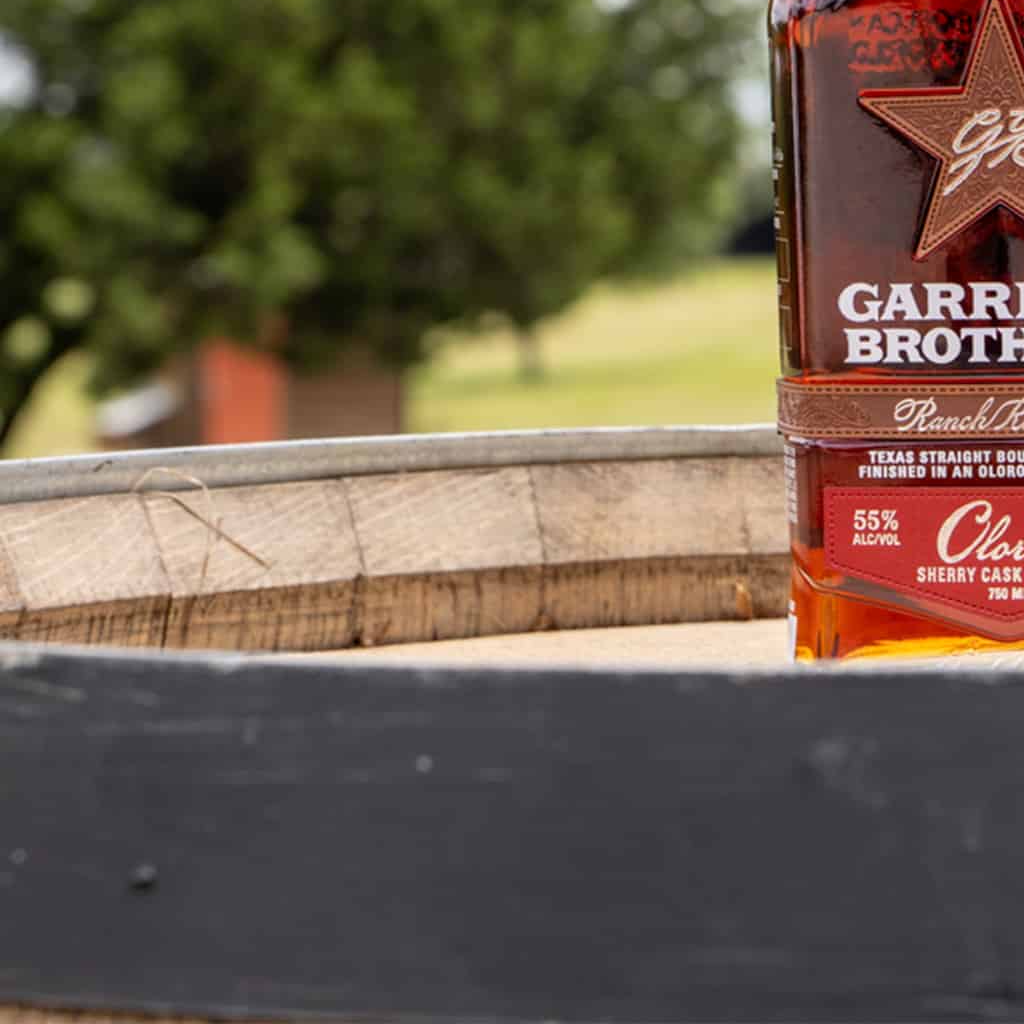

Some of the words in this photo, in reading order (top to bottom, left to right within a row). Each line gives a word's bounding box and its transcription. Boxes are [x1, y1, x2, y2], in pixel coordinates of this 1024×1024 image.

[894, 396, 994, 432] Ranch
[869, 450, 915, 464] TEXAS
[919, 450, 992, 464] STRAIGHT
[858, 465, 927, 479] FINISHED
[931, 465, 947, 479] IN
[951, 465, 973, 478] AN
[853, 509, 899, 531] 55%
[852, 532, 901, 546] ALC/VOL
[916, 566, 977, 583] SHERRY
[980, 566, 1023, 583] CASK
